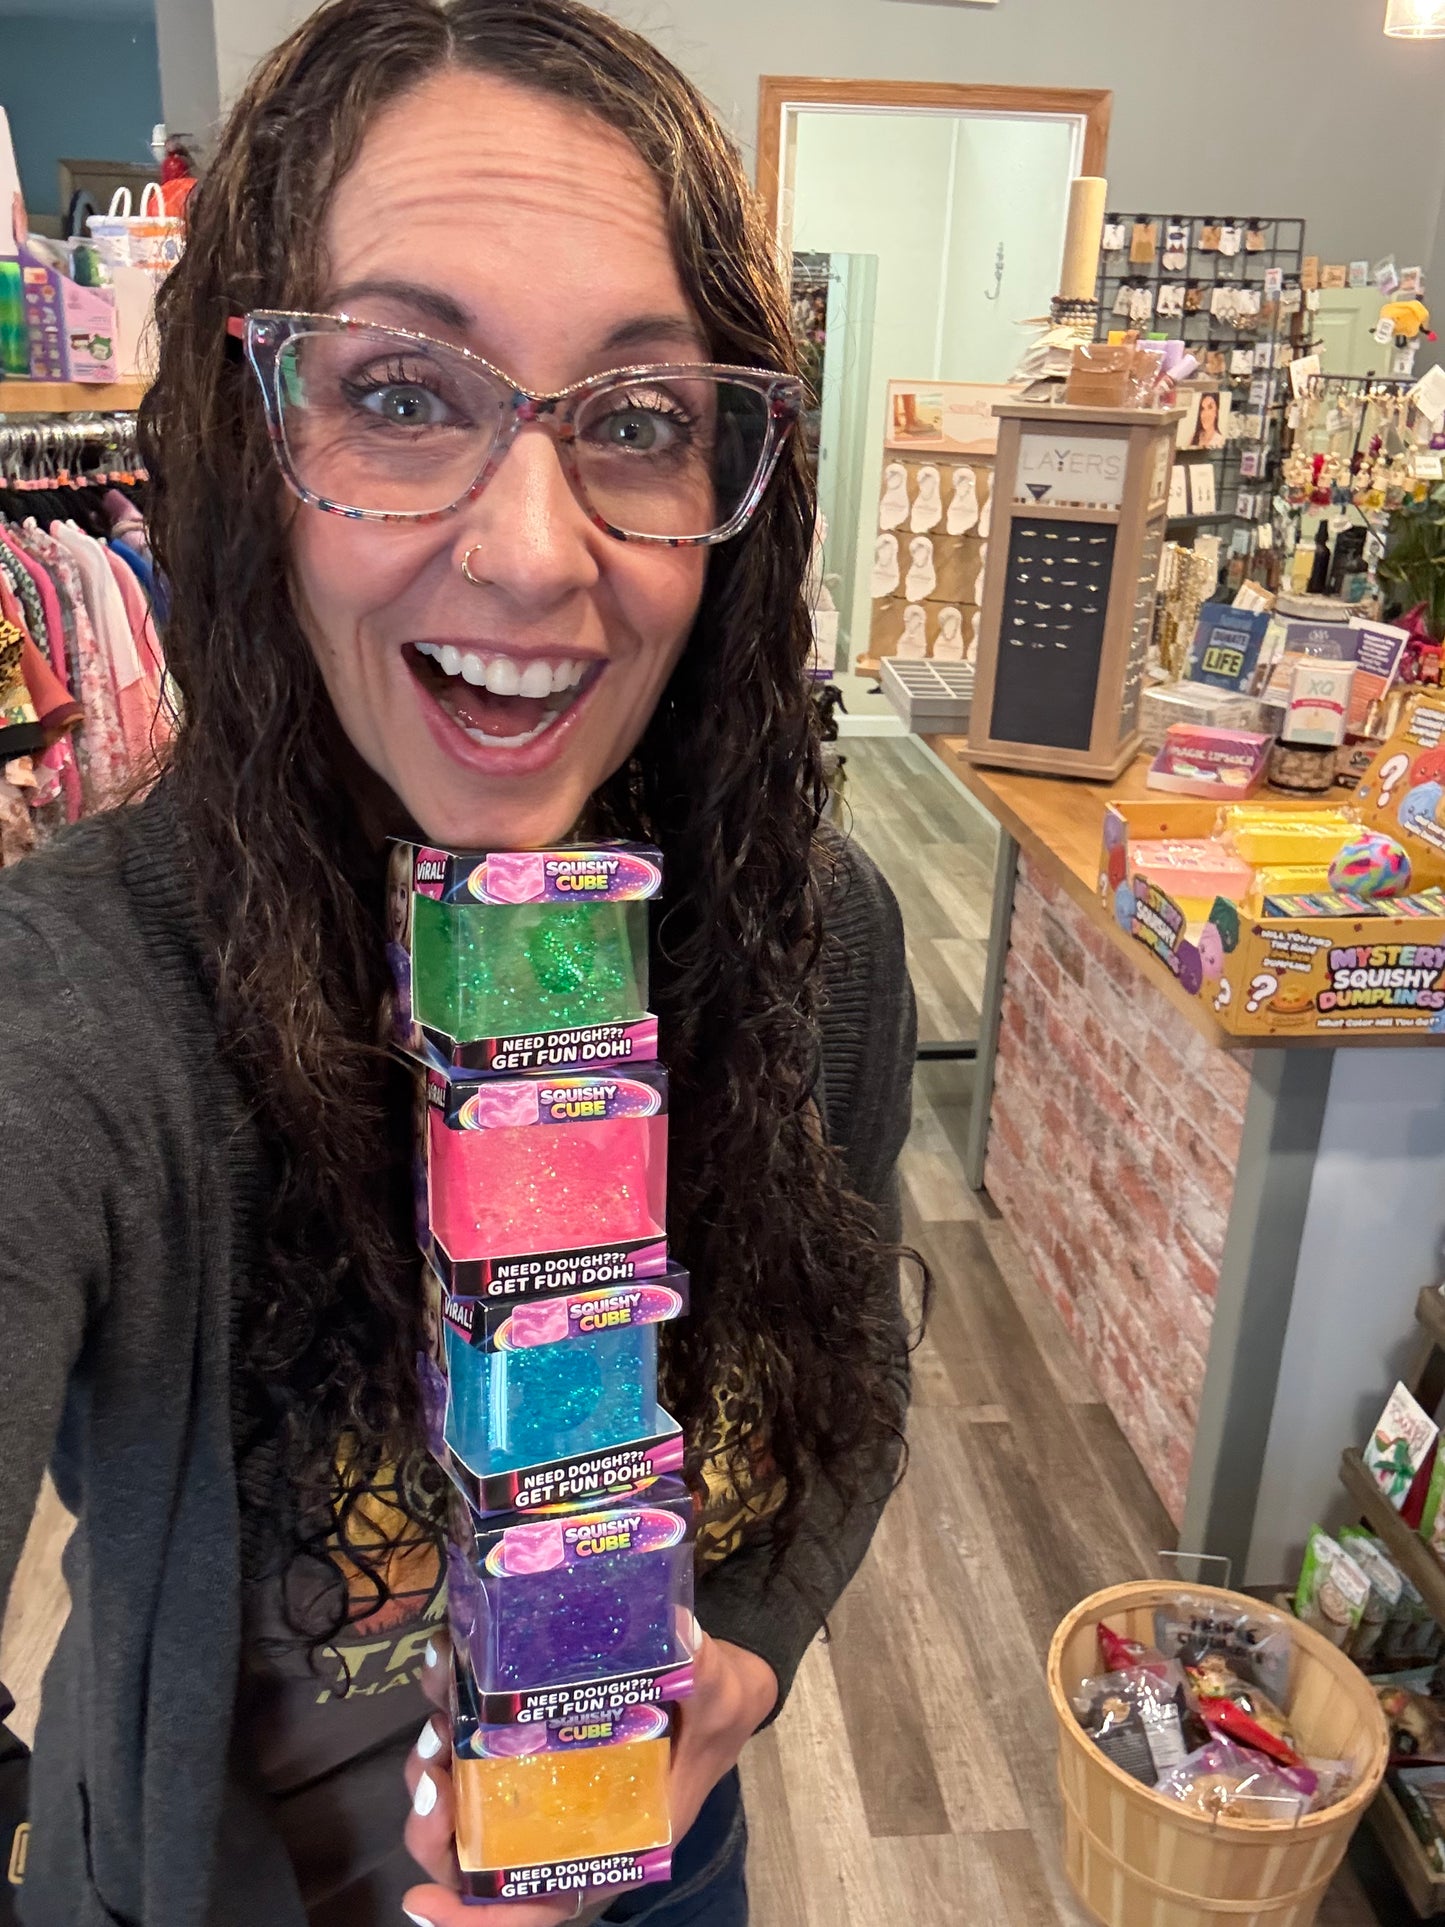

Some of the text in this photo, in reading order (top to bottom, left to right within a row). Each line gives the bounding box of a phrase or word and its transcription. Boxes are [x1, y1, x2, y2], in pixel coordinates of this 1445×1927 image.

[1023, 448, 1121, 476] LAYERS
[1205, 651, 1240, 674] LIFE
[546, 860, 619, 876] SQUISHY
[555, 875, 609, 891] CUBE
[1330, 945, 1445, 969] MYSTERY
[1333, 968, 1439, 990] SQUISHY
[1319, 988, 1445, 1010] DUMPLINGS
[502, 1027, 624, 1052] NEED DOUGH???
[491, 1039, 632, 1070] GET FUN DOH!
[540, 1085, 617, 1105] SQUISHY
[550, 1101, 606, 1119] CUBE
[497, 1253, 626, 1278] NEED DOUGH???
[487, 1263, 634, 1296] GET FUN DOH!
[569, 1292, 641, 1321] SQUISHY
[579, 1308, 632, 1332] CUBE
[523, 1451, 645, 1490] NEED DOUGH???
[514, 1485, 555, 1508] GET
[558, 1475, 599, 1497] FUN
[603, 1460, 653, 1483] DOH!
[565, 1516, 642, 1544] SQUISHY
[575, 1532, 632, 1557] CUBE
[516, 1687, 662, 1723] GET FUN DOH!
[526, 1678, 655, 1709] NEED DOUGH???
[558, 1722, 613, 1743] CUBE
[501, 1866, 643, 1898] GET FUN DOH!
[509, 1856, 635, 1883] NEED DOUGH???
